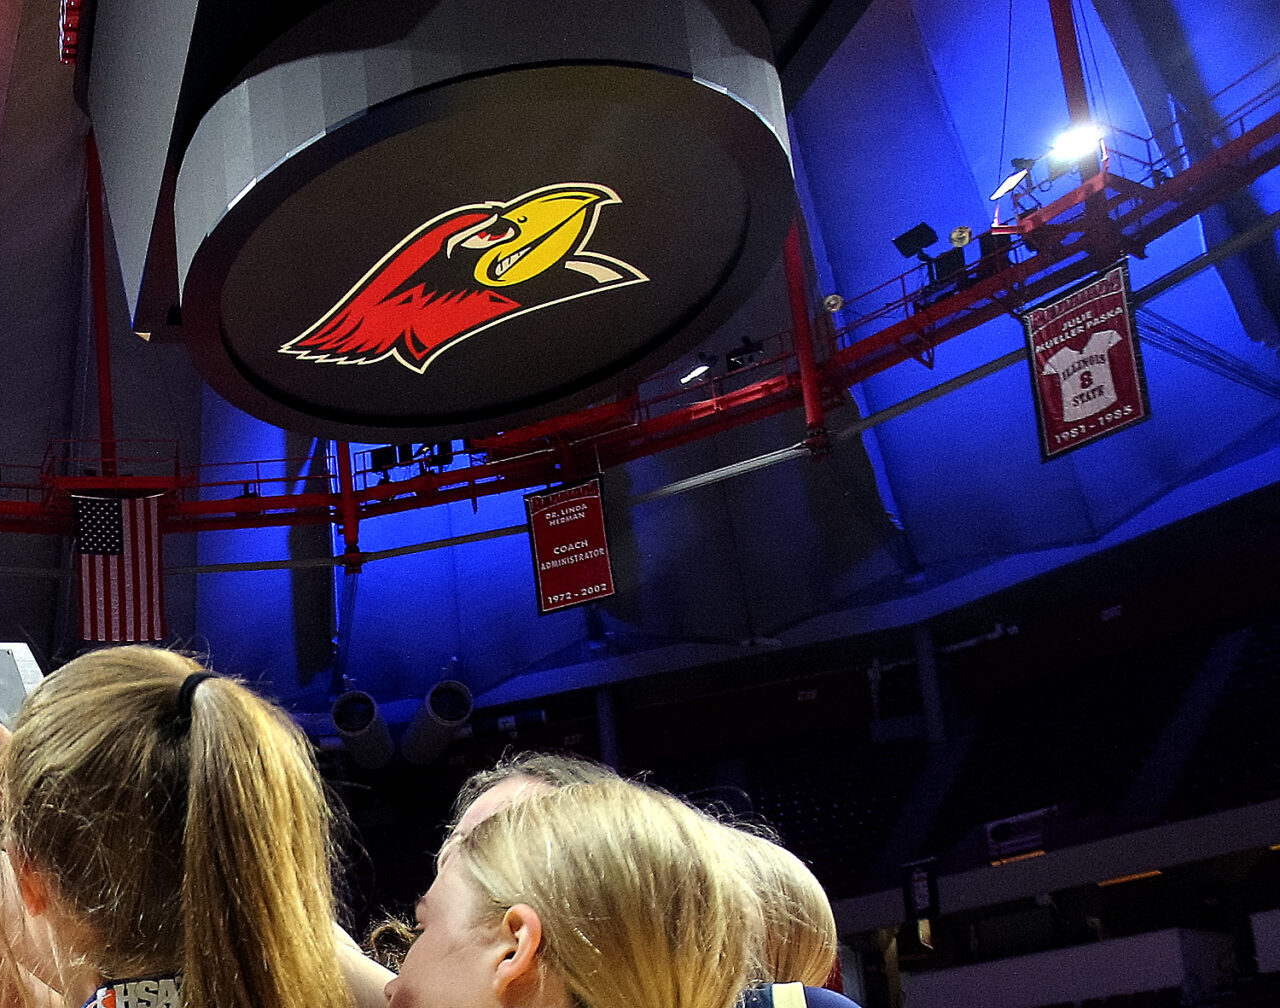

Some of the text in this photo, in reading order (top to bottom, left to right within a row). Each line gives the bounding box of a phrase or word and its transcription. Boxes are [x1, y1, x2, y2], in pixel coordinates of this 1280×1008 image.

[1062, 310, 1094, 332] JULIE
[1061, 353, 1107, 381] ILLINOIS
[1079, 371, 1094, 390] 8
[1072, 384, 1106, 407] STATE
[549, 511, 586, 526] HERMAN
[561, 503, 588, 516] LINDA
[553, 539, 589, 555] COACH
[540, 547, 605, 572] ADMINISTRATOR
[547, 593, 572, 605] 1972
[581, 583, 607, 597] 2002
